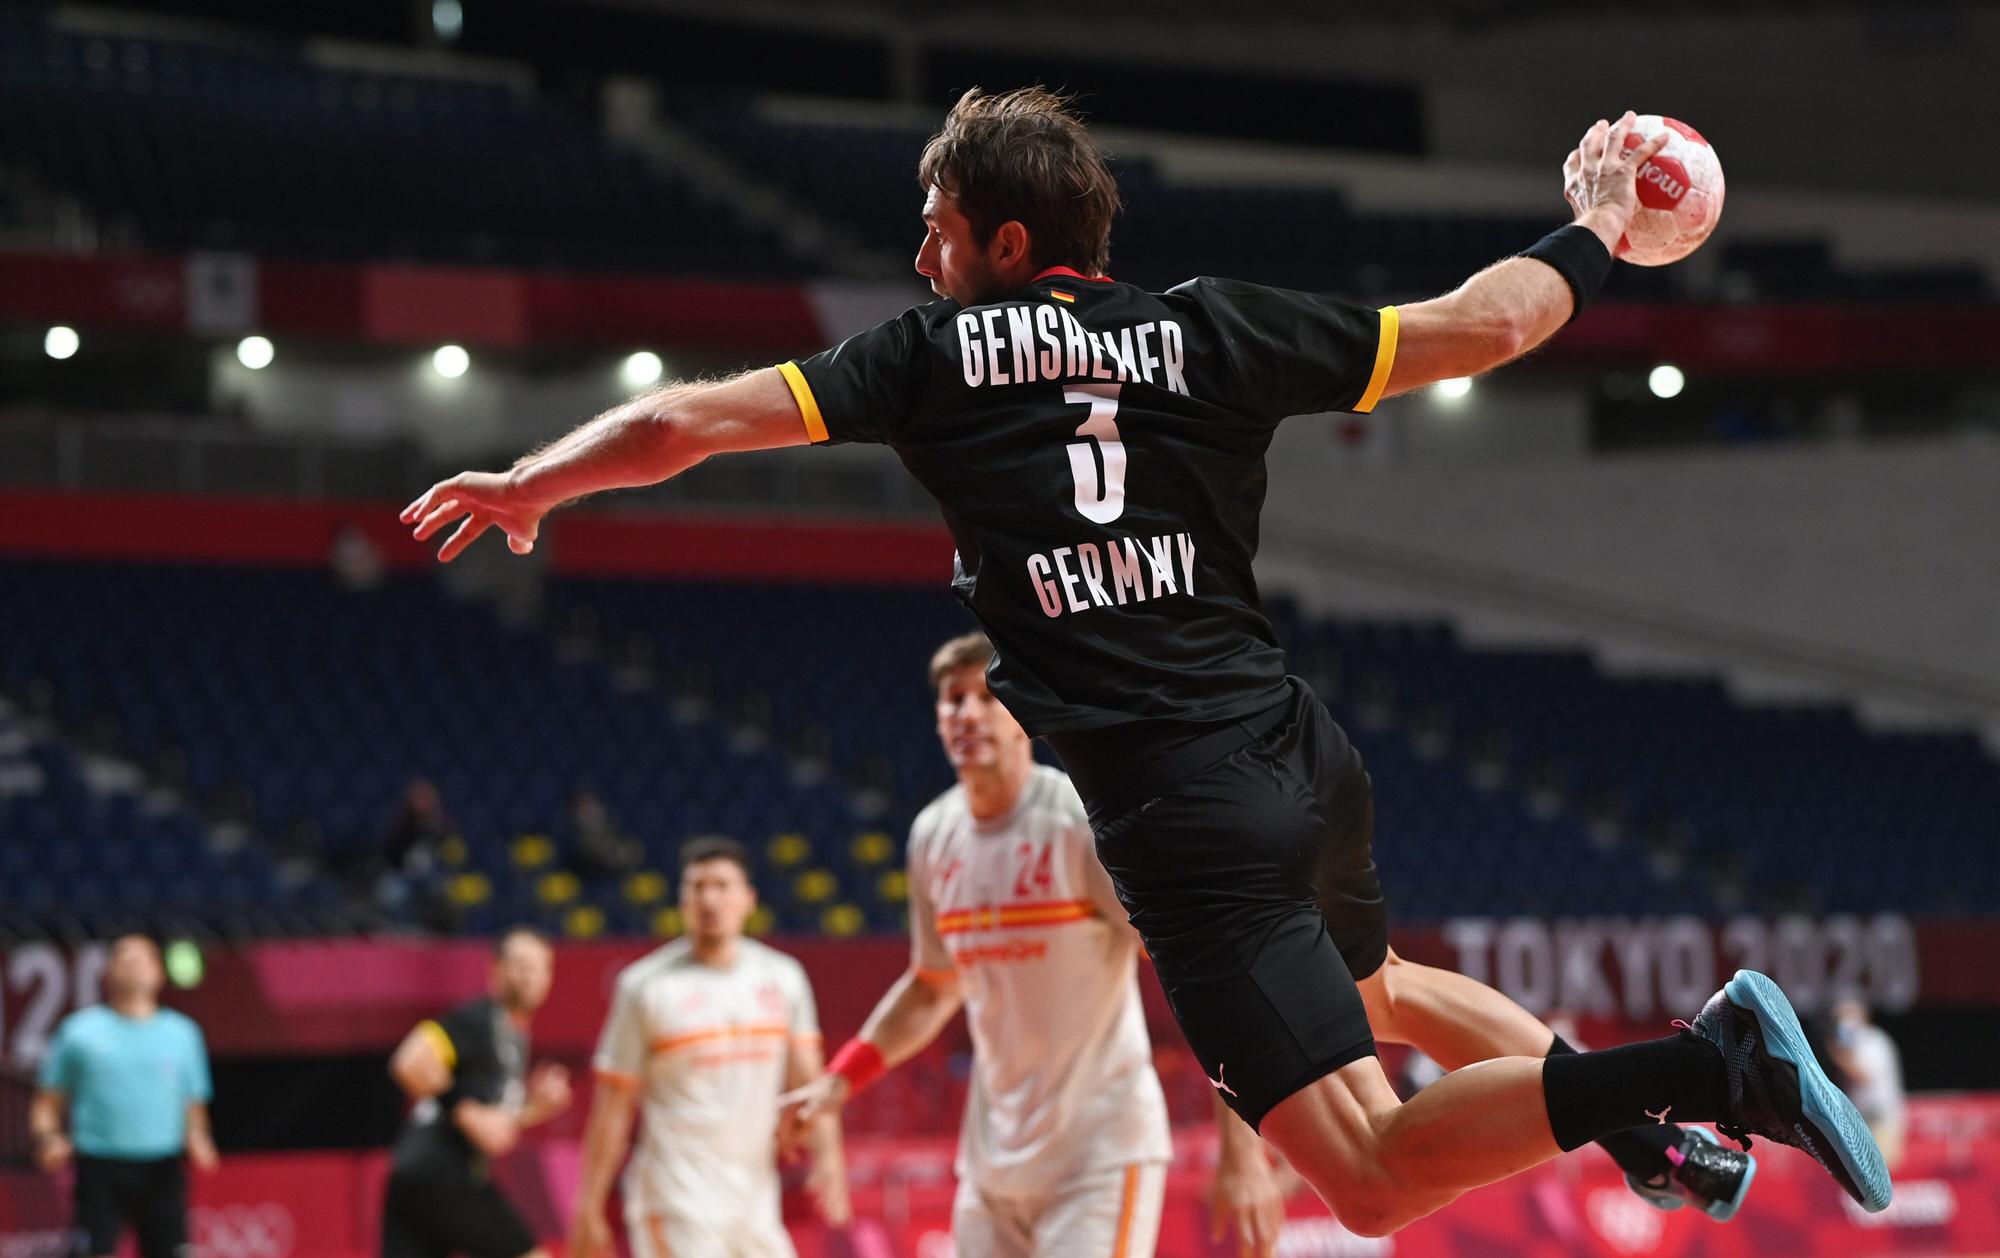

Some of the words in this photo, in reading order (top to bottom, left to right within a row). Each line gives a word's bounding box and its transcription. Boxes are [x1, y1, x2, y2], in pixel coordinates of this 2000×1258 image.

[1635, 160, 1685, 200] mol
[1062, 383, 1128, 524] 3
[1026, 532, 1196, 618] GERMANY
[1014, 842, 1054, 897] 24
[1446, 915, 1714, 1017] TOKYO
